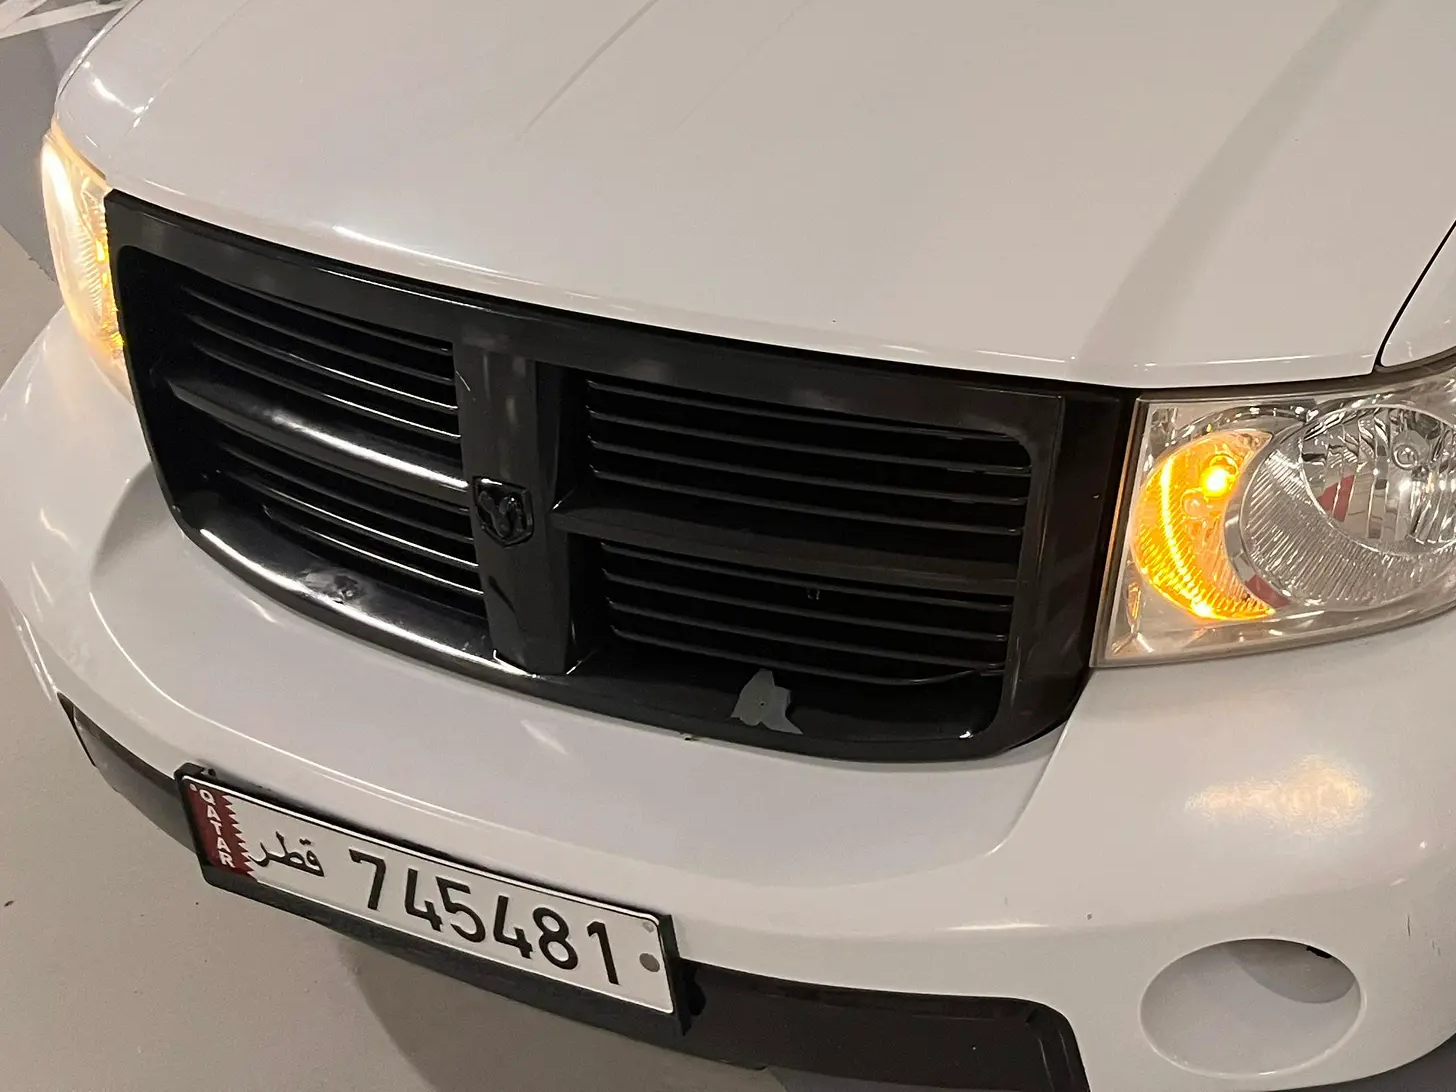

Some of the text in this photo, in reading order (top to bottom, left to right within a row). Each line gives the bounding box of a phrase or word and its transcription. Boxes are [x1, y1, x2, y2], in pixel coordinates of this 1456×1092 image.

[198, 789, 237, 869] QATAR
[252, 831, 326, 878] قطر
[349, 848, 620, 986] 745481
